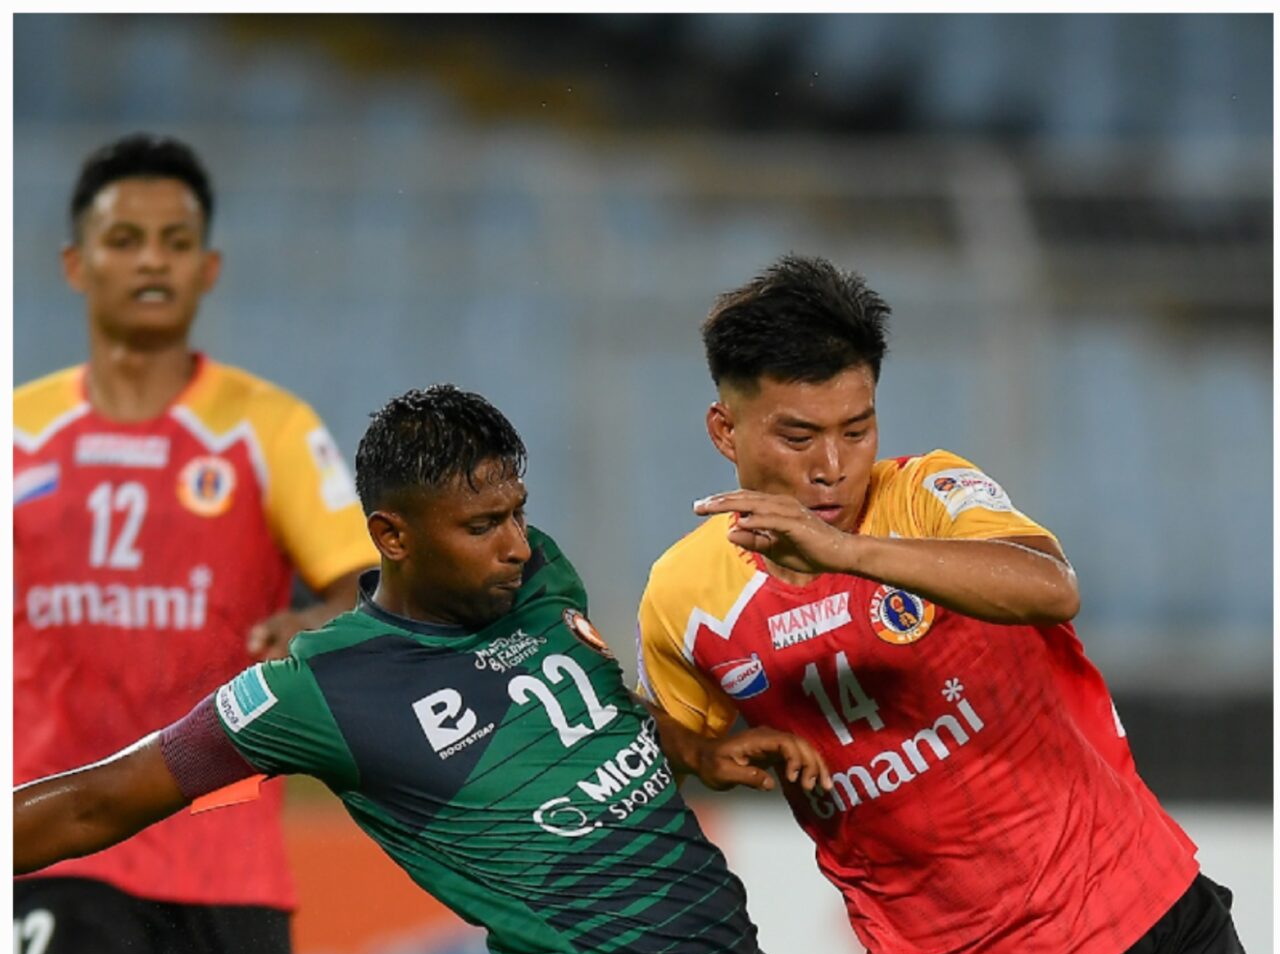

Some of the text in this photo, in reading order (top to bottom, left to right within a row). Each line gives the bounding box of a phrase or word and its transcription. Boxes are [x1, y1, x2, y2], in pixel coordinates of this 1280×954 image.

[86, 481, 149, 570] 12
[25, 566, 213, 630] emami
[770, 594, 847, 638] MANTRA
[507, 653, 618, 748] 22
[802, 651, 885, 747] 14
[803, 677, 985, 821] emami
